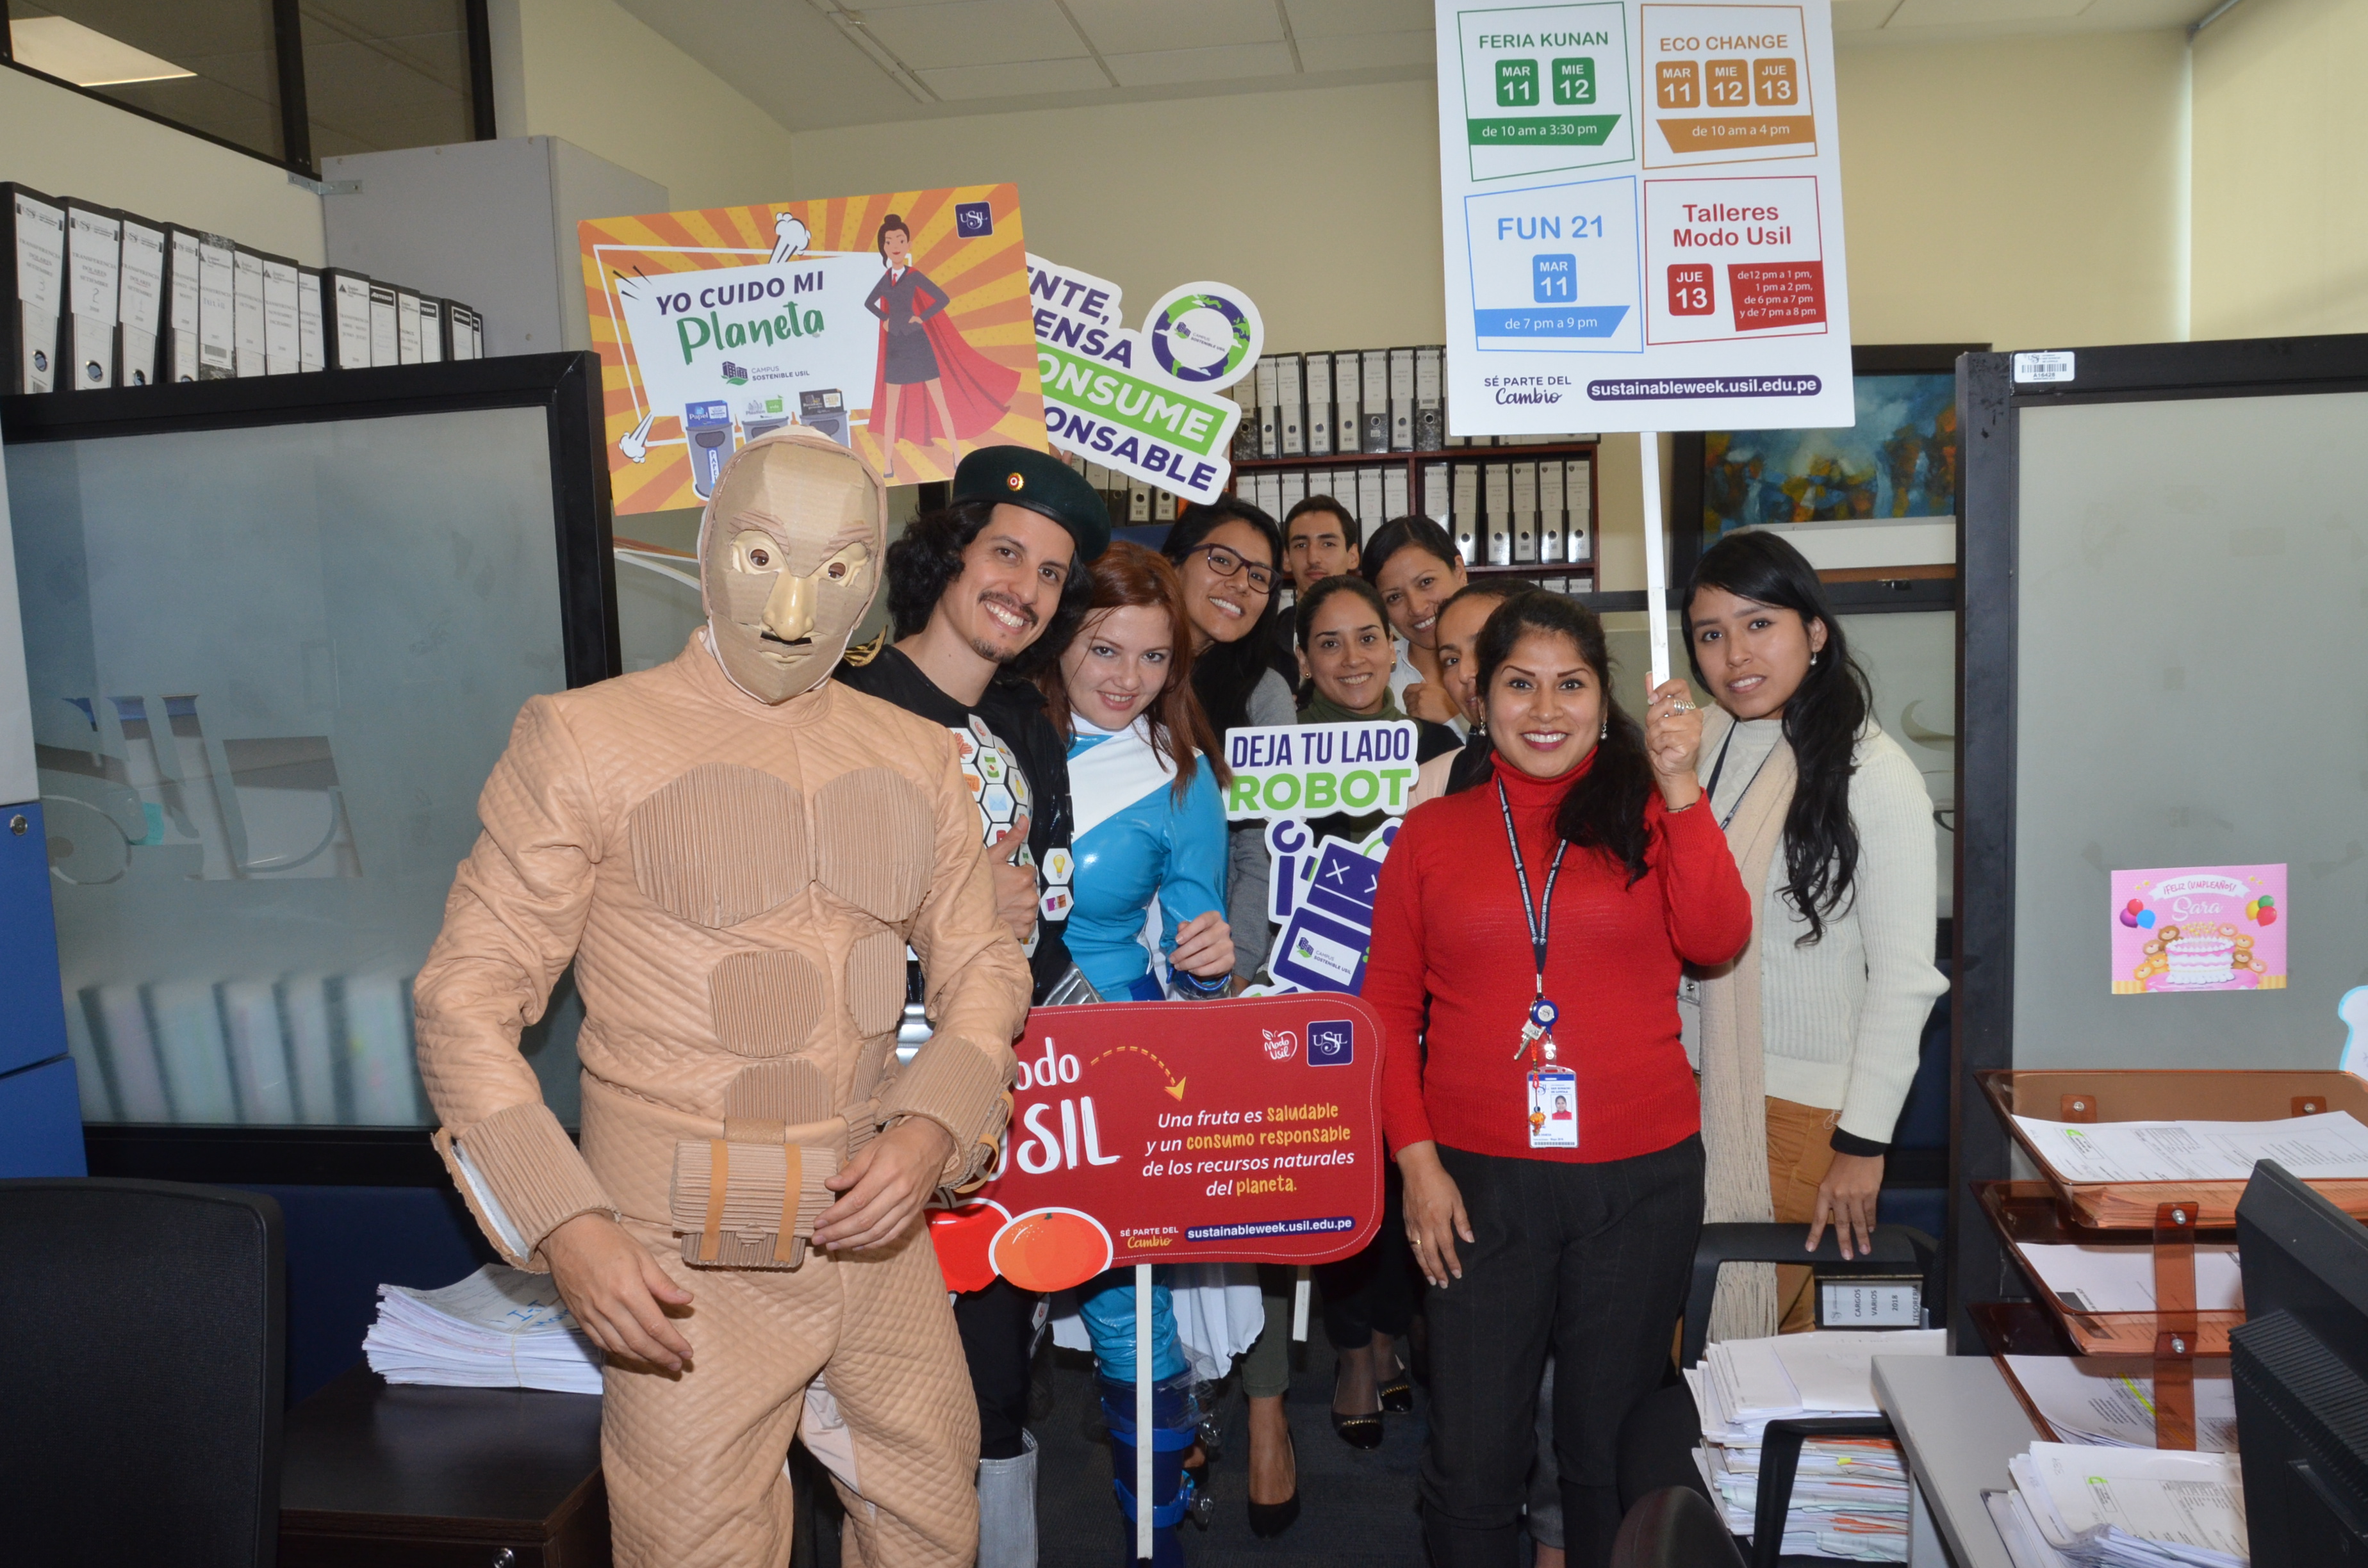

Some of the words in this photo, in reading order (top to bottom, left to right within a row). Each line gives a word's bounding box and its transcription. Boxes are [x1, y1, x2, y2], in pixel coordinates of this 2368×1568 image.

[1479, 34, 1535, 49] FERIA
[1540, 31, 1609, 47] KUNAN
[1660, 37, 1700, 51] ECO
[1706, 35, 1789, 51] CHANGE
[1502, 66, 1531, 76] MAR
[1561, 65, 1584, 75] MIE
[1663, 68, 1691, 78] MAR
[1714, 66, 1738, 77] MIE
[1761, 65, 1787, 76] JUE
[1503, 81, 1531, 101] 11
[1559, 80, 1590, 99] 12
[1665, 83, 1691, 102] 11
[1713, 82, 1743, 101] 12
[1761, 80, 1791, 100] 13
[1482, 126, 1497, 136] de
[1501, 126, 1515, 136] 10
[1518, 127, 1536, 136] am
[1540, 127, 1546, 135] a
[1550, 124, 1574, 135] 3:30
[1578, 125, 1597, 136] pm
[1692, 126, 1707, 136] de
[1712, 126, 1725, 136] 10
[1728, 127, 1747, 135] am
[1760, 124, 1767, 135] 4
[1770, 126, 1789, 136] pm
[960, 210, 987, 229] USIL
[1682, 204, 1779, 222] Talleres
[1497, 216, 1561, 240] FUN
[1571, 215, 1602, 238] 21
[1673, 227, 1739, 247] Modo
[1746, 225, 1791, 245] Usil
[1540, 261, 1568, 272] MAR
[1676, 272, 1703, 282] JUE
[1763, 272, 1777, 281] pm
[1795, 271, 1813, 280] pm,
[656, 291, 691, 315] YO
[699, 278, 785, 309] CUIDO
[794, 270, 824, 292] MI
[1540, 277, 1568, 297] 11
[1756, 283, 1759, 291] 1
[1763, 284, 1778, 293] pm
[1788, 282, 1793, 291] 2
[1795, 283, 1813, 292] pm,
[1675, 288, 1708, 309] 13
[1744, 295, 1756, 304] de
[1757, 295, 1764, 304] 6
[1766, 296, 1781, 306] pm
[1798, 295, 1813, 305] pm
[1739, 310, 1745, 319] y
[1747, 307, 1759, 316] de
[1761, 308, 1766, 316] 7
[1768, 309, 1784, 318] pm
[1793, 307, 1799, 316] 8
[1801, 308, 1816, 317] pm
[676, 300, 825, 365] Planeta
[1505, 318, 1520, 329] de
[1524, 318, 1530, 329] 7
[1534, 320, 1554, 331] pm
[1557, 320, 1563, 328] a
[1567, 317, 1574, 327] 9
[1578, 318, 1597, 330] pm
[1032, 305, 1132, 369] ENSA
[752, 372, 793, 381] SOSTENIBLE
[1484, 375, 1499, 388] SÉ
[1503, 377, 1544, 387] PARTE
[1549, 376, 1572, 386] DEL
[1495, 387, 1563, 405] Cambio
[1591, 378, 1818, 397] sustainableweek.usil.edu.pe
[689, 412, 709, 421] Papel
[1232, 734, 1292, 767] DEJA
[1301, 731, 1333, 765] TU
[1341, 728, 1409, 763] LADO
[1229, 769, 1411, 812] ROBOT
[2172, 897, 2223, 922] Sara
[1264, 1036, 1289, 1051] Modo
[1312, 1031, 1347, 1056] USIL
[1270, 1046, 1290, 1060] Usil
[1014, 1037, 1080, 1090] odo
[1158, 1113, 1192, 1128] Una
[1197, 1110, 1240, 1125] fruta
[1244, 1111, 1262, 1122] es
[1267, 1102, 1338, 1122] saludable
[1144, 1141, 1156, 1157] y
[1160, 1139, 1182, 1152] un
[1187, 1132, 1254, 1150] consumo
[1260, 1125, 1351, 1147] responsable
[1142, 1161, 1163, 1177] de
[1168, 1159, 1192, 1175] los
[1197, 1157, 1269, 1173] recursos
[1274, 1150, 1354, 1168] naturales
[1206, 1180, 1233, 1196] del
[1236, 1174, 1297, 1196] planeta.
[1120, 1227, 1130, 1237] SÉ
[1133, 1228, 1161, 1236] PARTE
[1162, 1226, 1179, 1235] DEL
[1188, 1219, 1353, 1239] sustainableweek.usil.edu.pe
[1128, 1236, 1172, 1249] Cambio
